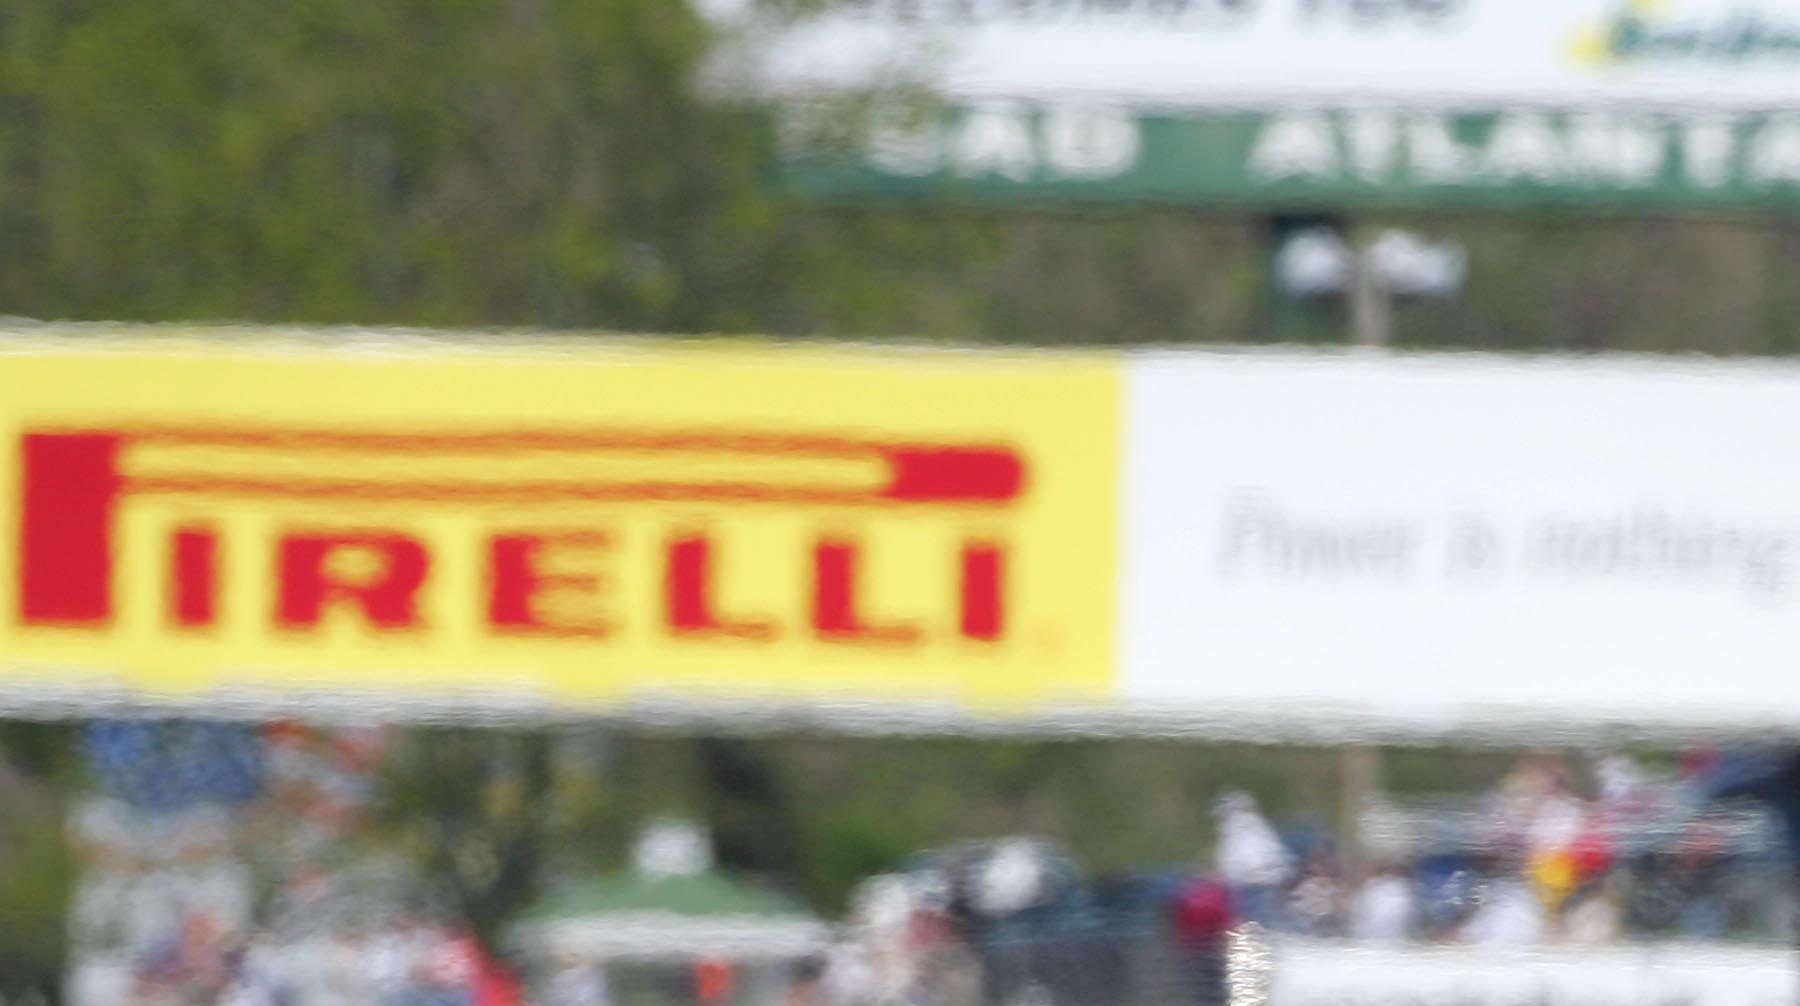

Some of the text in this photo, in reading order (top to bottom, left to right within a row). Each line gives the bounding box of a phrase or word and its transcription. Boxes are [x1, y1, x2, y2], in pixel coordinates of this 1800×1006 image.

[15, 428, 1029, 643] PIRELLI
[1213, 490, 1421, 580] Power
[1446, 510, 1502, 577] is
[1524, 505, 1800, 600] nothing
